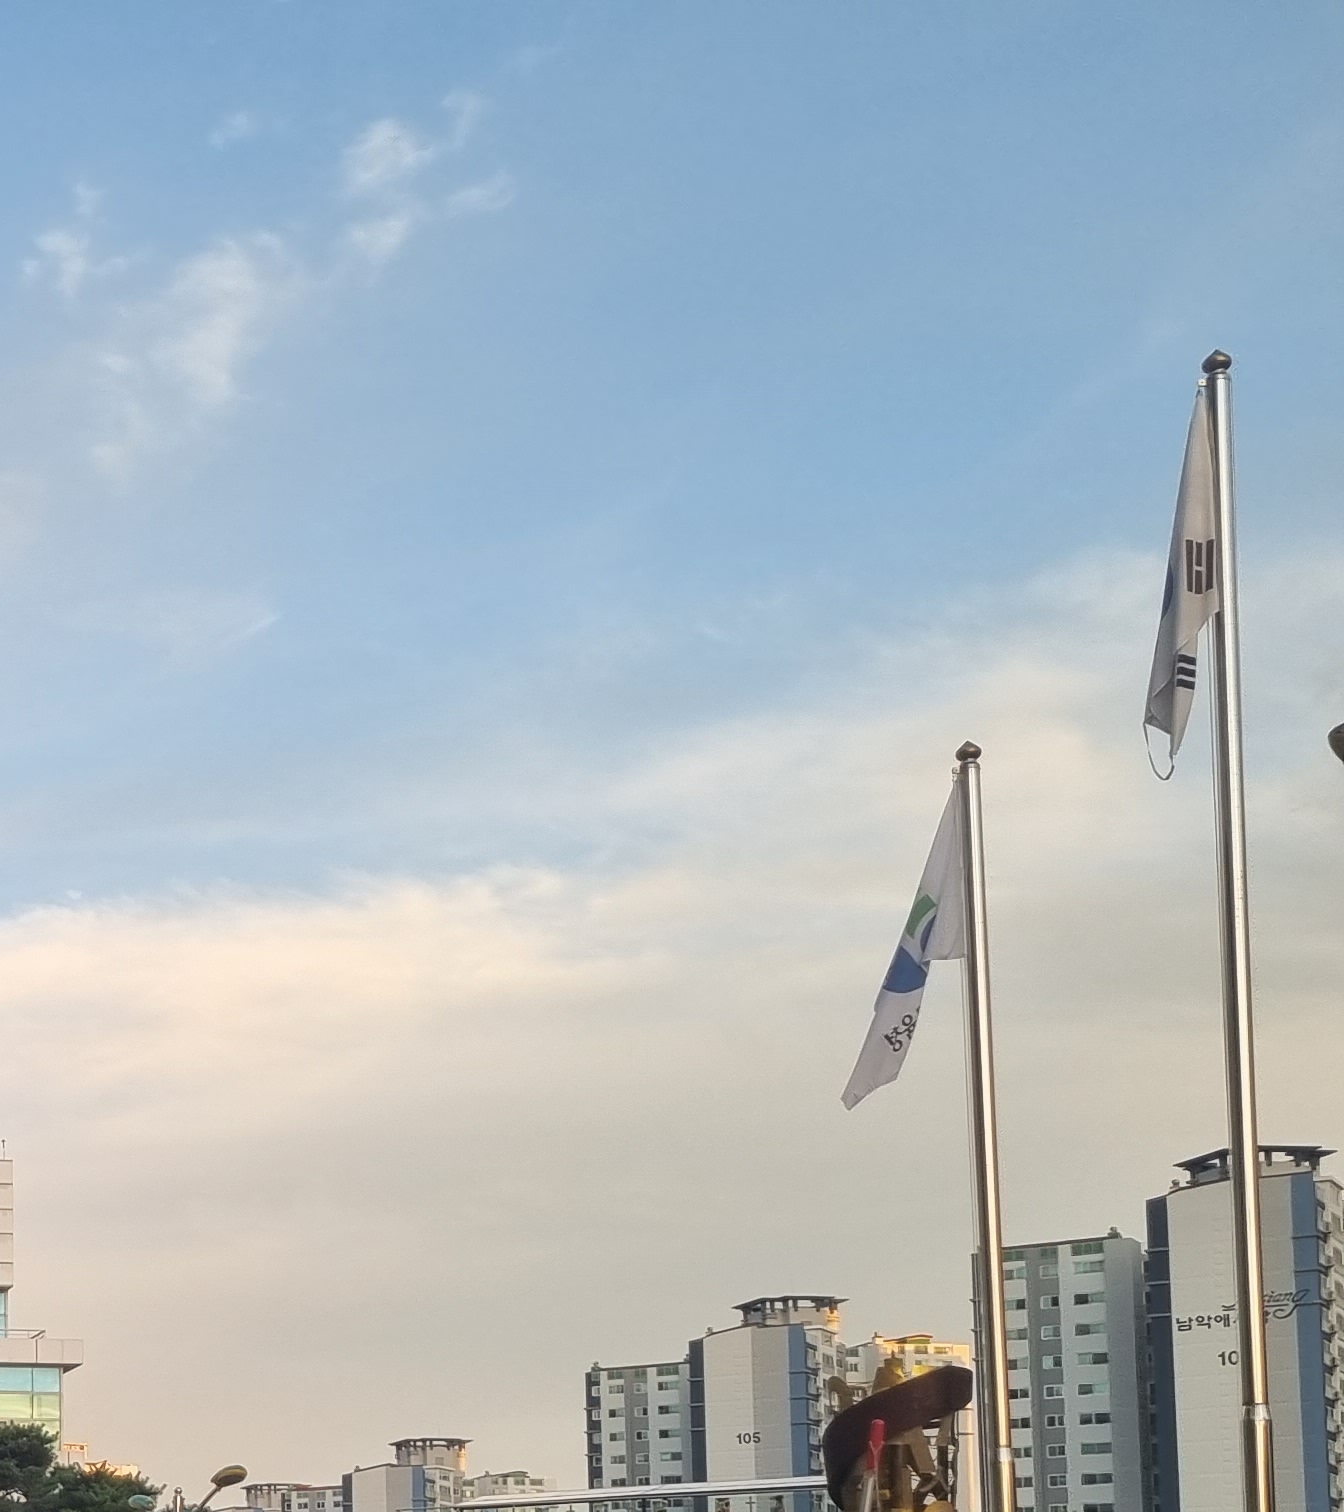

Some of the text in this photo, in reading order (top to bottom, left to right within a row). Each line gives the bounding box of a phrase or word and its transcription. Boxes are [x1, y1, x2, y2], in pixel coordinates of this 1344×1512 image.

[1175, 1313, 1237, 1332] 남악에
[1218, 1351, 1238, 1366] 10
[736, 1432, 761, 1446] 105
